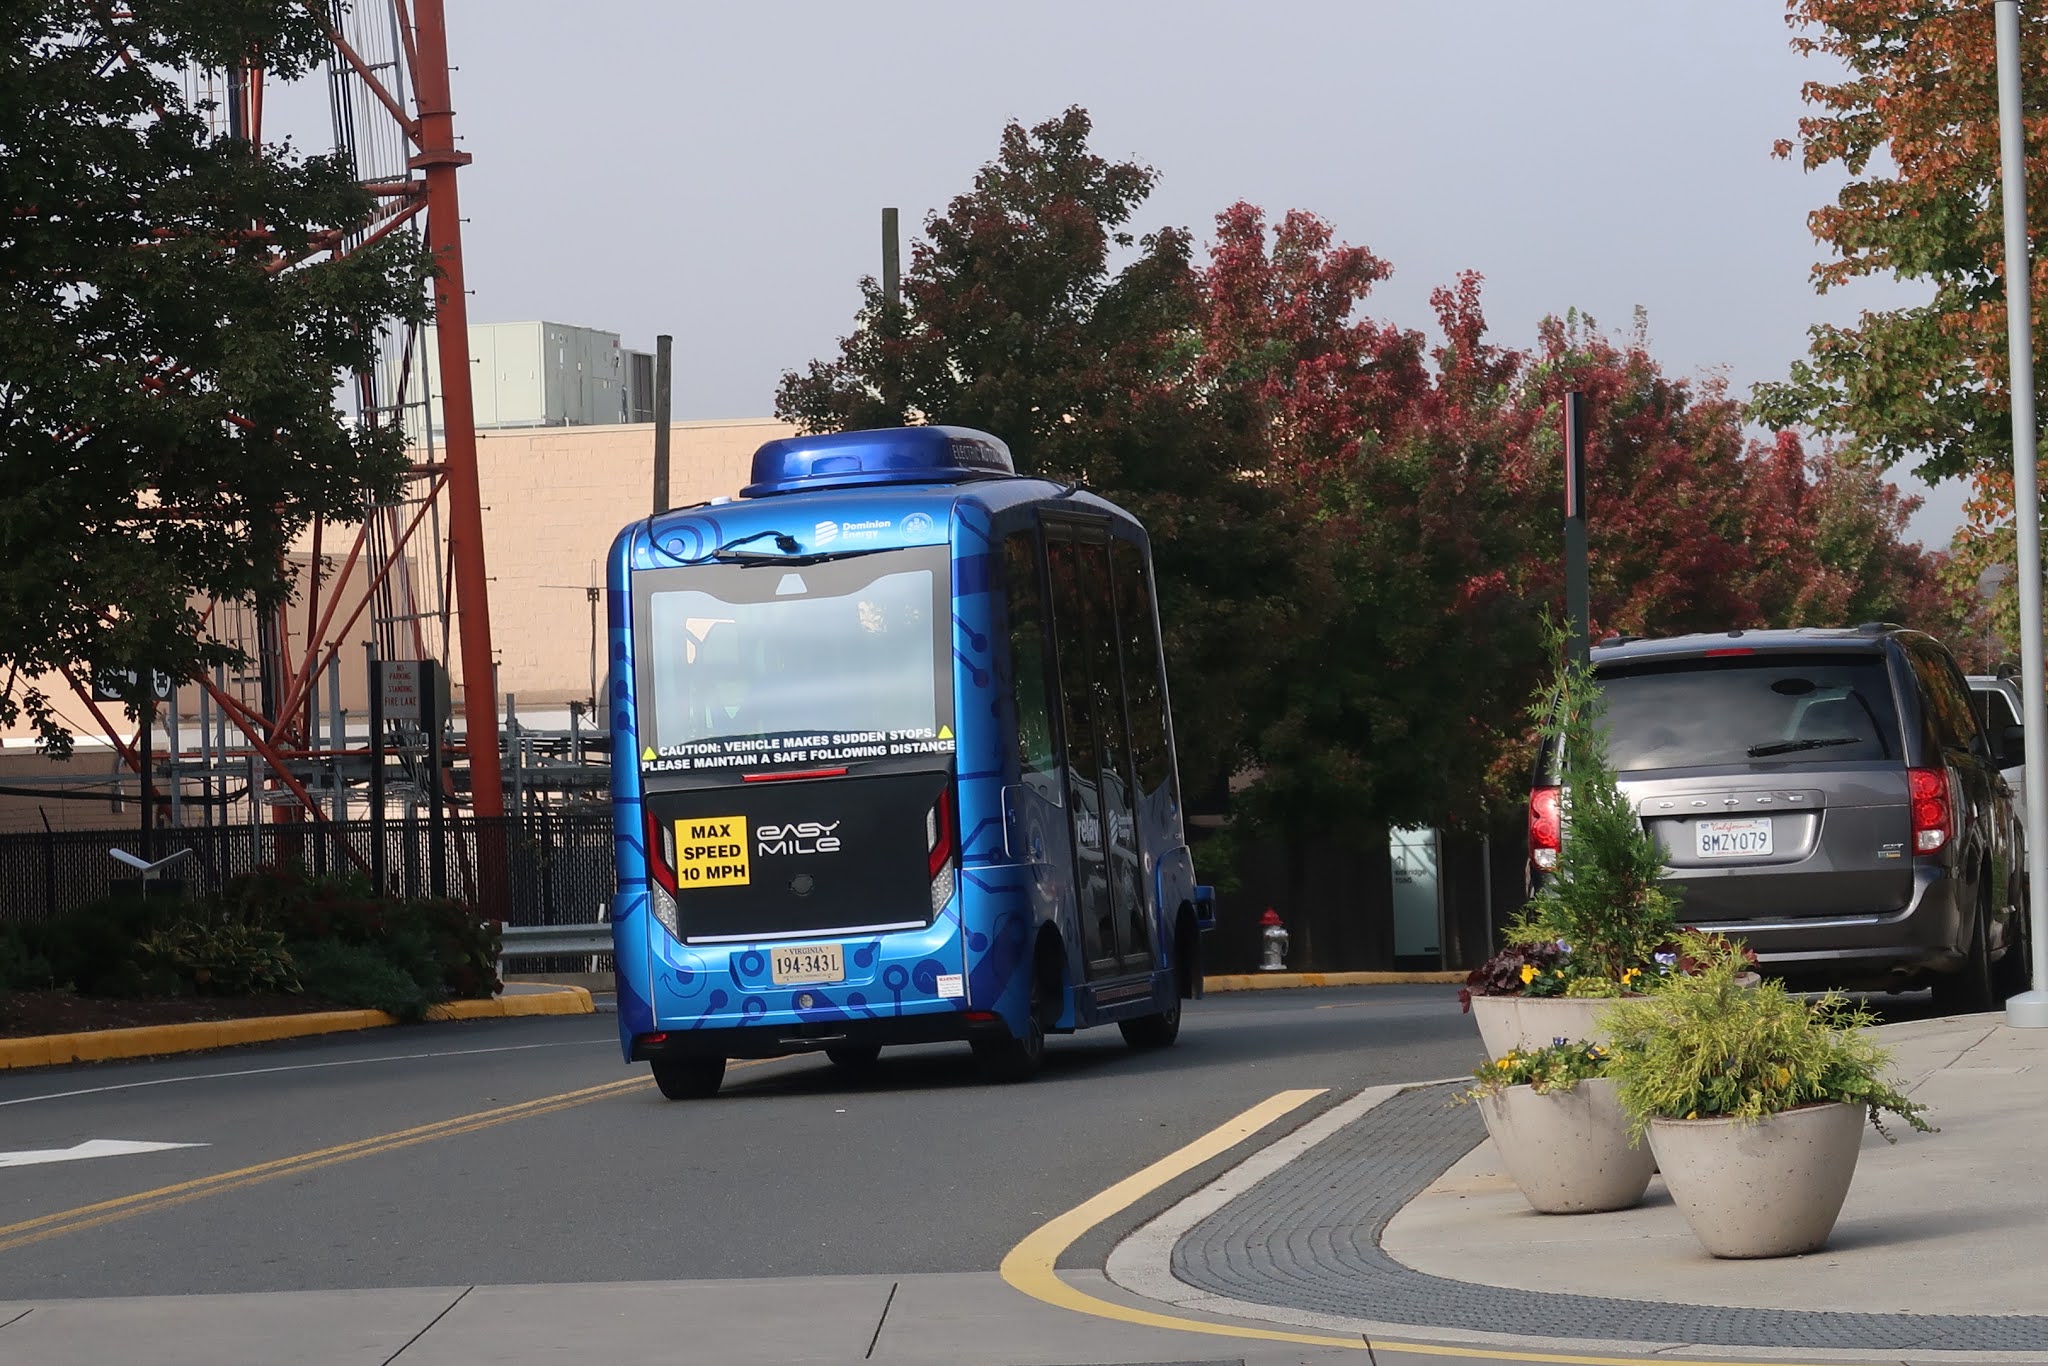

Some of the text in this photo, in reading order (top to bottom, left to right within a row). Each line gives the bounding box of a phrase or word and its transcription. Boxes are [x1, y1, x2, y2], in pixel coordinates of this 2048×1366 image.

[843, 520, 891, 531] Dominion
[843, 530, 879, 540] Energy
[385, 696, 417, 706] FIRE LANE
[659, 727, 936, 757] CAUTION: VEHICLE MAKES SUDDEN STOPS.
[641, 740, 956, 772] PLEASE MAINTAIN A SAFE FOLLOWING DISTANCE
[691, 824, 731, 839] MAX
[1711, 822, 1757, 833] California
[1702, 831, 1768, 852] 8MZY079
[684, 844, 741, 860] SPEED
[682, 864, 746, 881] 10 MPH
[789, 947, 824, 955] VIRGINIA
[777, 954, 840, 975] 194-343L
